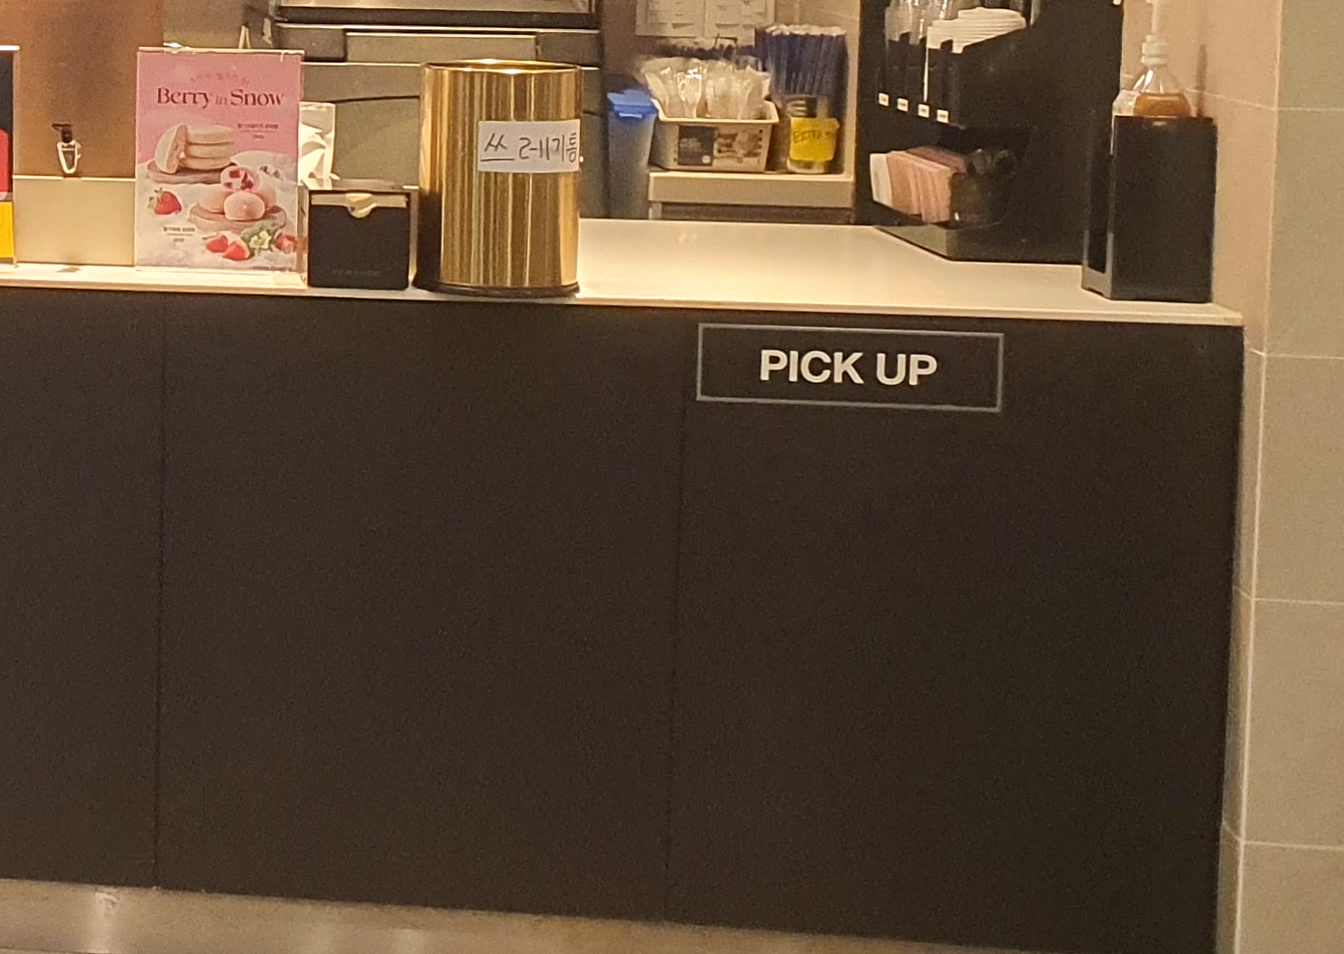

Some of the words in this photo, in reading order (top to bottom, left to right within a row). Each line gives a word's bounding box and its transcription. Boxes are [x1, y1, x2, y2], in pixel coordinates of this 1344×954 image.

[157, 87, 211, 110] Berry
[215, 95, 228, 106] in
[229, 88, 284, 107] Snow
[759, 348, 864, 385] PICK
[875, 350, 938, 386] UP
